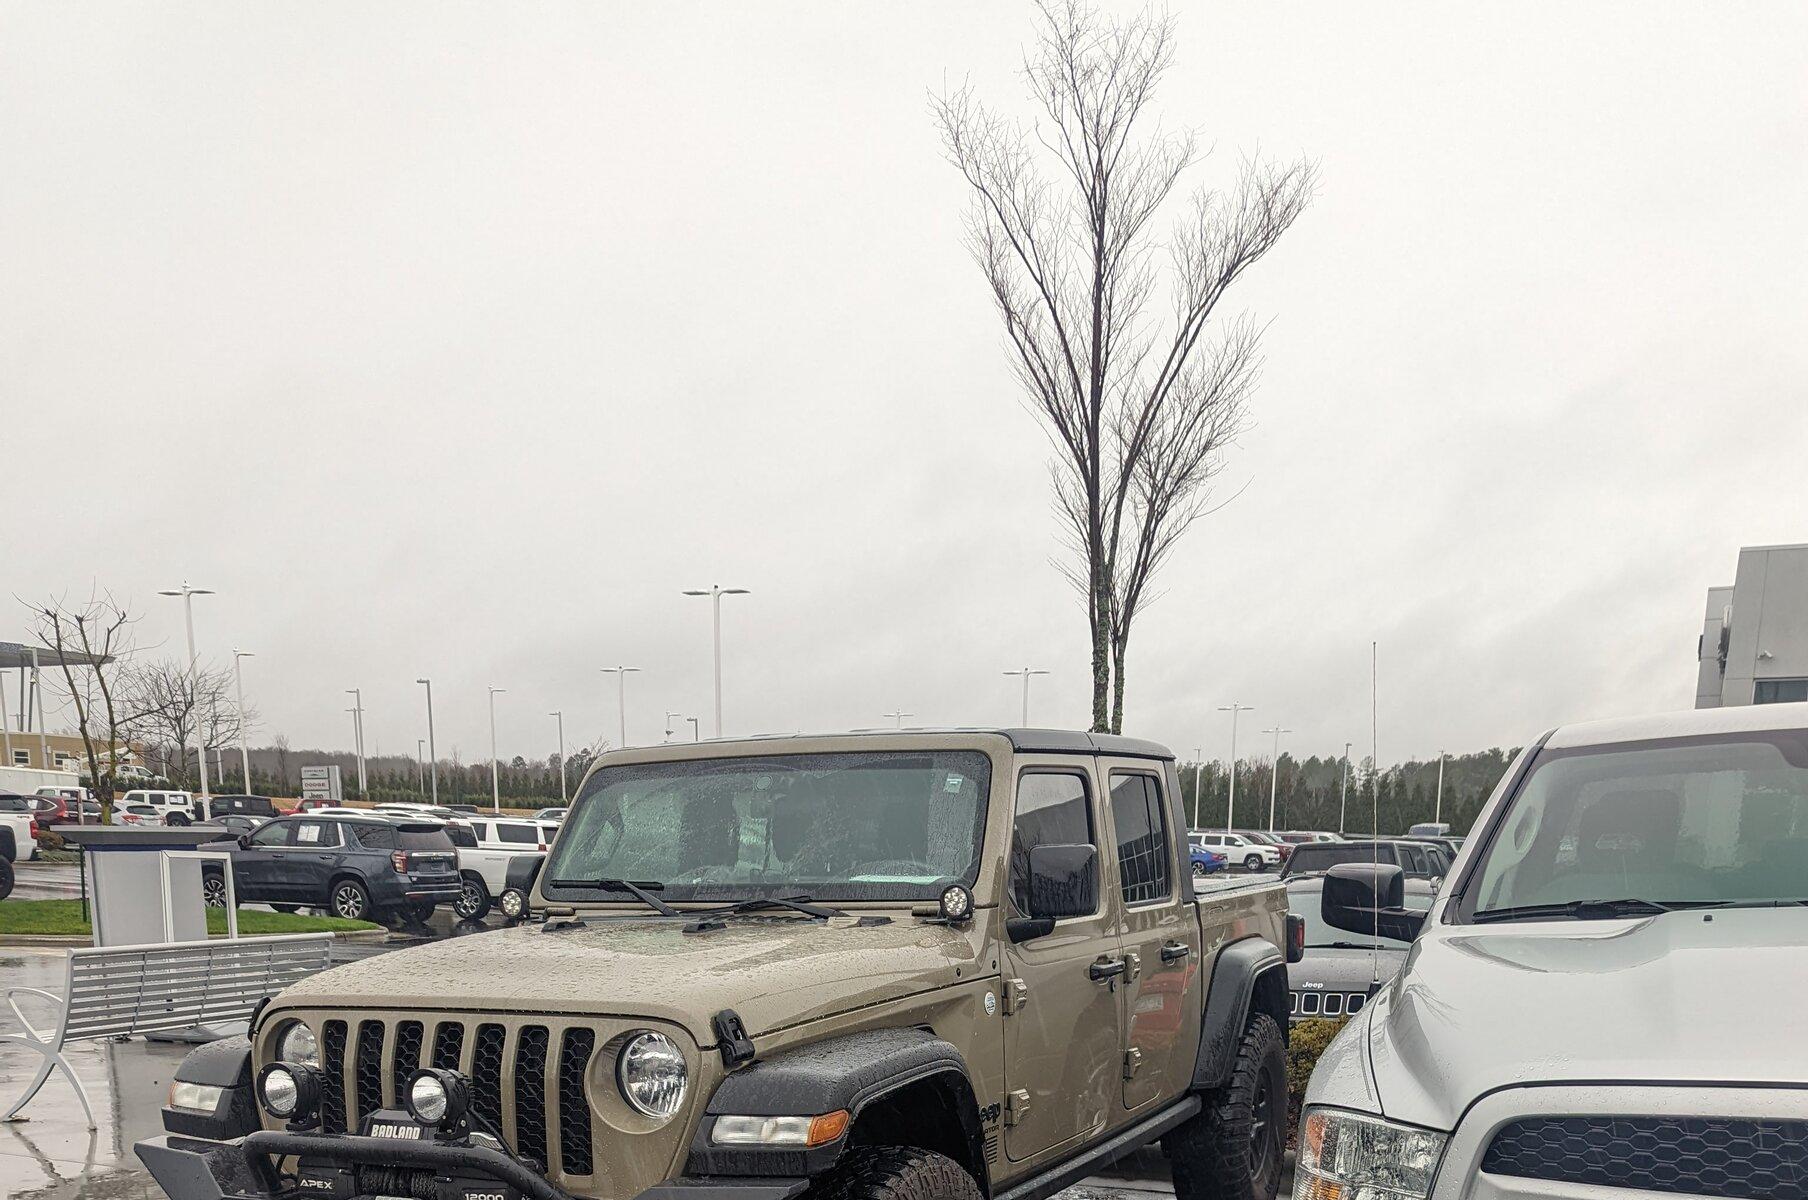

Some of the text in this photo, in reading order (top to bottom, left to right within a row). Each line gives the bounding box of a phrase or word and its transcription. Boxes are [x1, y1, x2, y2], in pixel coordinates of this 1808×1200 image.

[1302, 981, 1323, 989] Jeep
[979, 1102, 1001, 1123] eep
[370, 1124, 420, 1140] BADLAND
[299, 1178, 333, 1190] APEX
